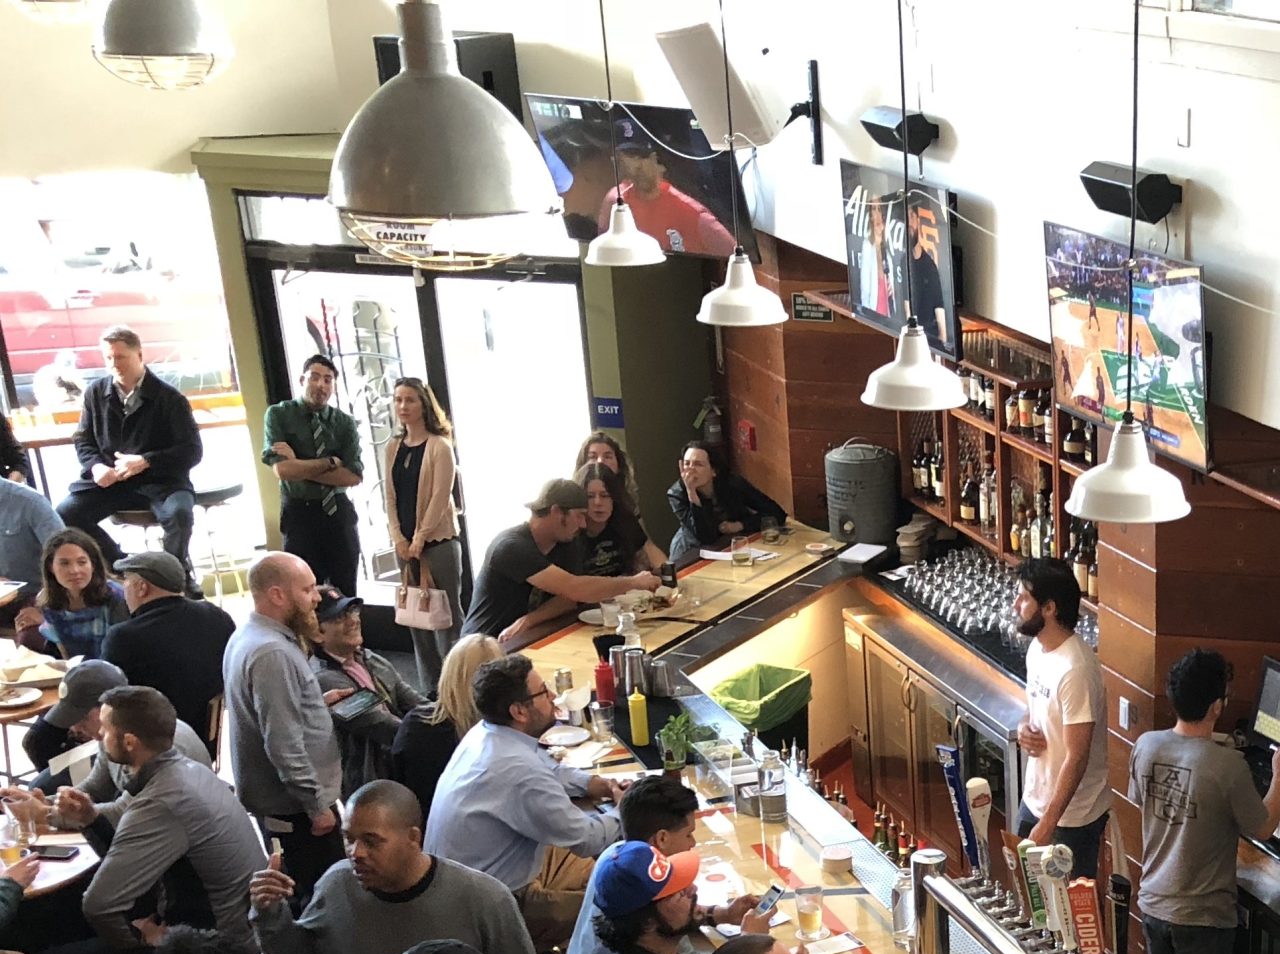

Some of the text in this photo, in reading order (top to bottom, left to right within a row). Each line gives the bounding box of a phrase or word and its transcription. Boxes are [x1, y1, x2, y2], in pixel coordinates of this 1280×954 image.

[845, 185, 905, 256] Alka
[376, 231, 427, 242] CAPACITY
[597, 405, 620, 414] EXIT
[1163, 768, 1182, 788] A
